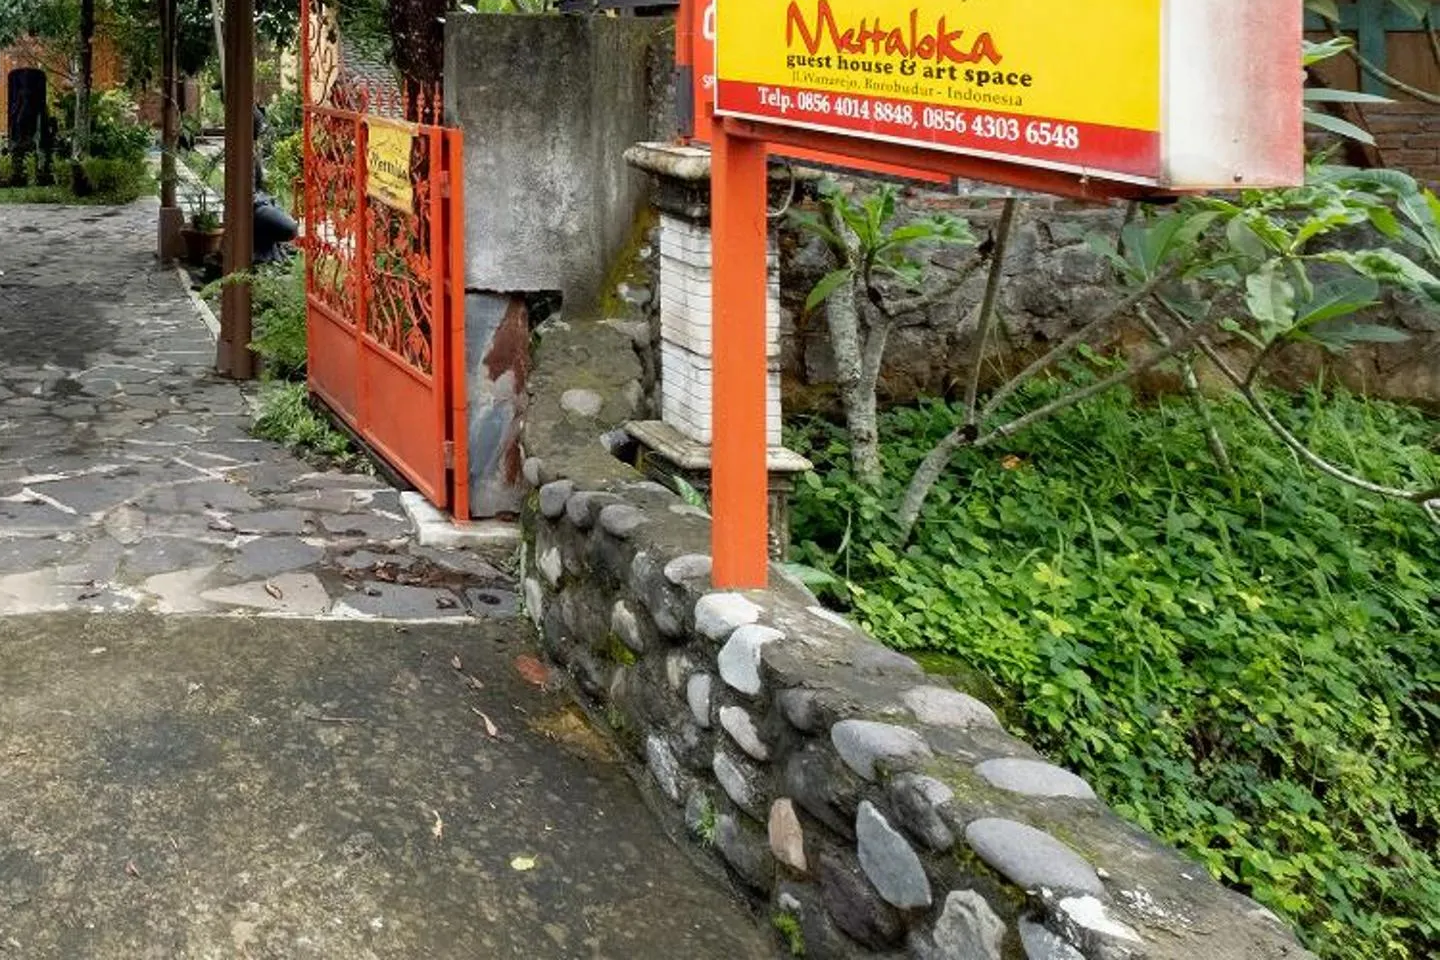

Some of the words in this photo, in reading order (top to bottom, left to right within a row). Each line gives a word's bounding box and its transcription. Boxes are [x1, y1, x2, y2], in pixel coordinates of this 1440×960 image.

[786, 54, 831, 68] guest
[837, 55, 893, 74] house
[900, 59, 917, 76] &
[923, 65, 957, 81] art
[964, 68, 1032, 87] space
[947, 86, 1023, 106] Indonesia
[757, 86, 794, 113] Telp.
[797, 91, 831, 114] 0856
[833, 96, 870, 119] 4014
[873, 101, 918, 129] 8848,
[923, 107, 967, 133] 0856
[971, 114, 1020, 141] 4303
[1025, 120, 1080, 149] 6548
